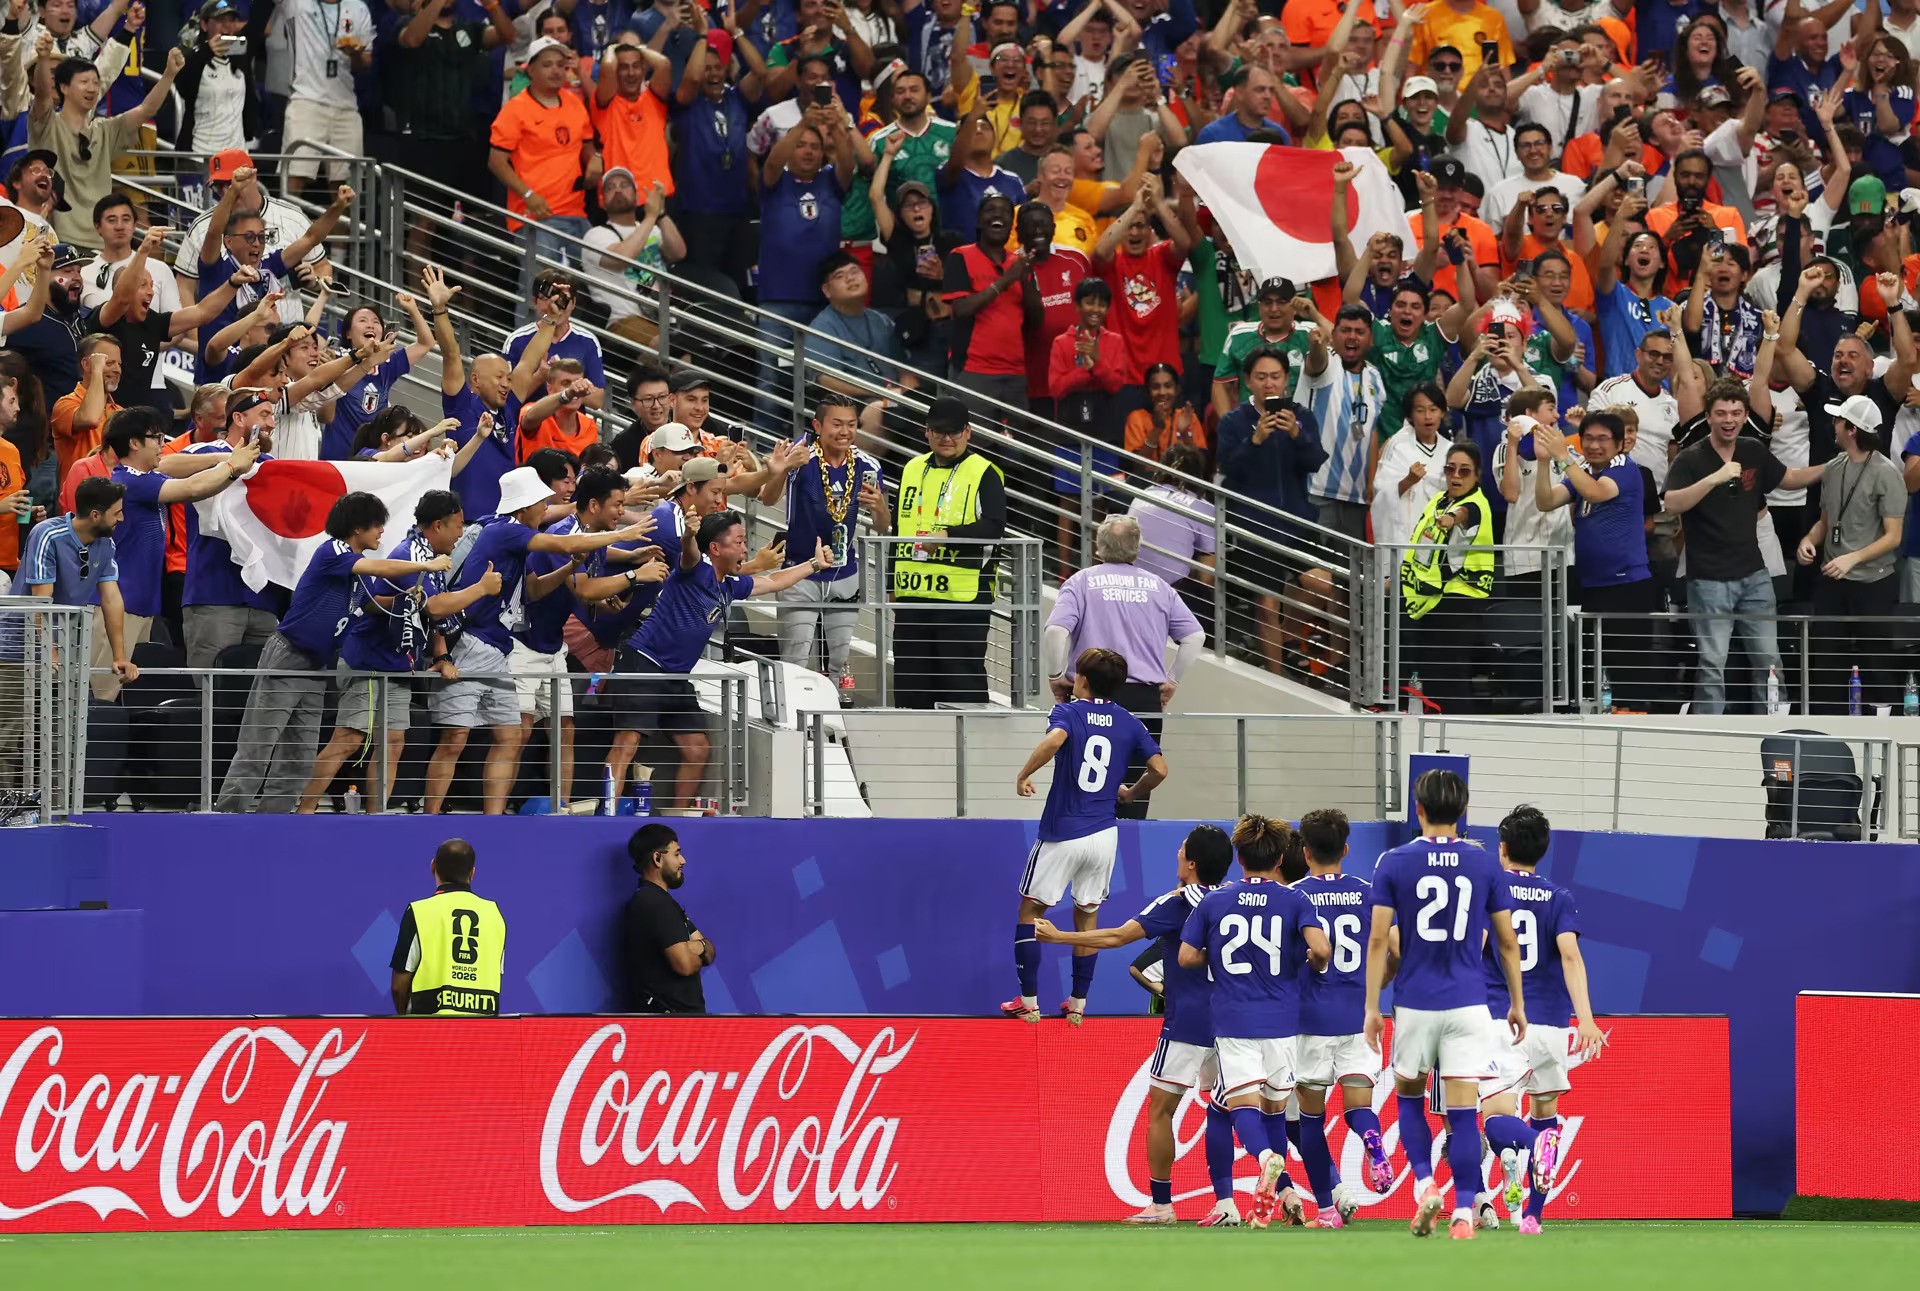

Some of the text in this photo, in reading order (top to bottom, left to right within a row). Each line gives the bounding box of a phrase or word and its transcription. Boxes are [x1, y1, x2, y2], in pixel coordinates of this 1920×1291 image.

[1088, 574, 1159, 590] STADIUM FAN
[1102, 588, 1148, 603] SERVICES
[1087, 712, 1113, 727] KUBO
[1077, 734, 1112, 793] 8
[1428, 852, 1459, 867] H.ITO
[1238, 892, 1268, 907] SANO
[1509, 885, 1552, 902] NIGUCHI
[1415, 875, 1473, 942] 21
[1219, 913, 1283, 976] 24
[458, 952, 471, 960] FIFA
[452, 972, 477, 981] 2026
[539, 1023, 920, 1213] Coca-Cola
